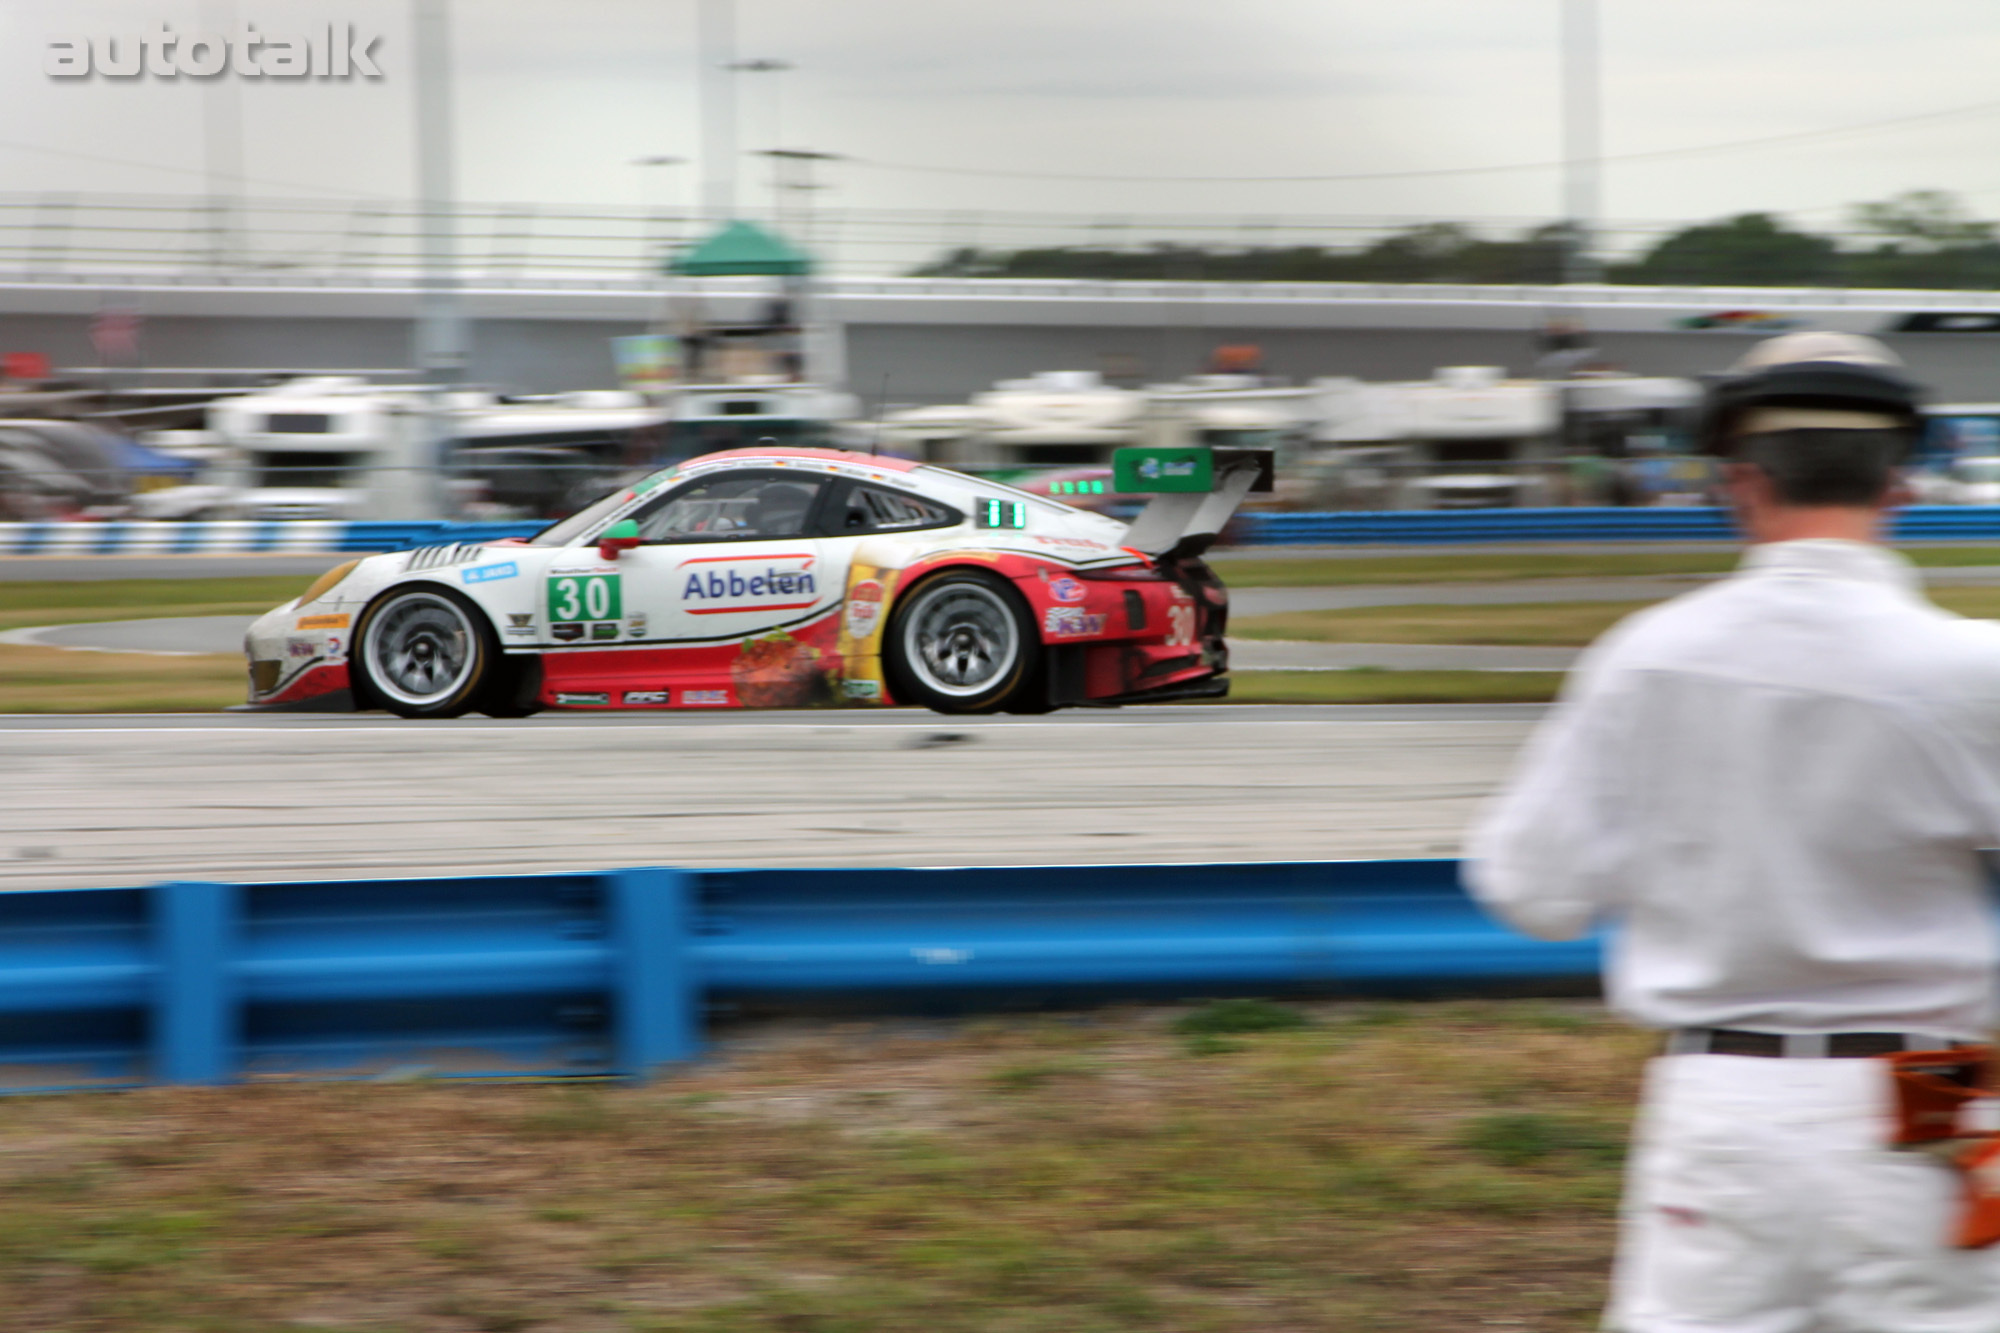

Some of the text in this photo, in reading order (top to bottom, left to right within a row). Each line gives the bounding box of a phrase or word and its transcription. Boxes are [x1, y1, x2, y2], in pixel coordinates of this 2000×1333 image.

[556, 577, 610, 620] 30
[682, 567, 816, 600] Abbelen
[1165, 605, 1196, 647] 30
